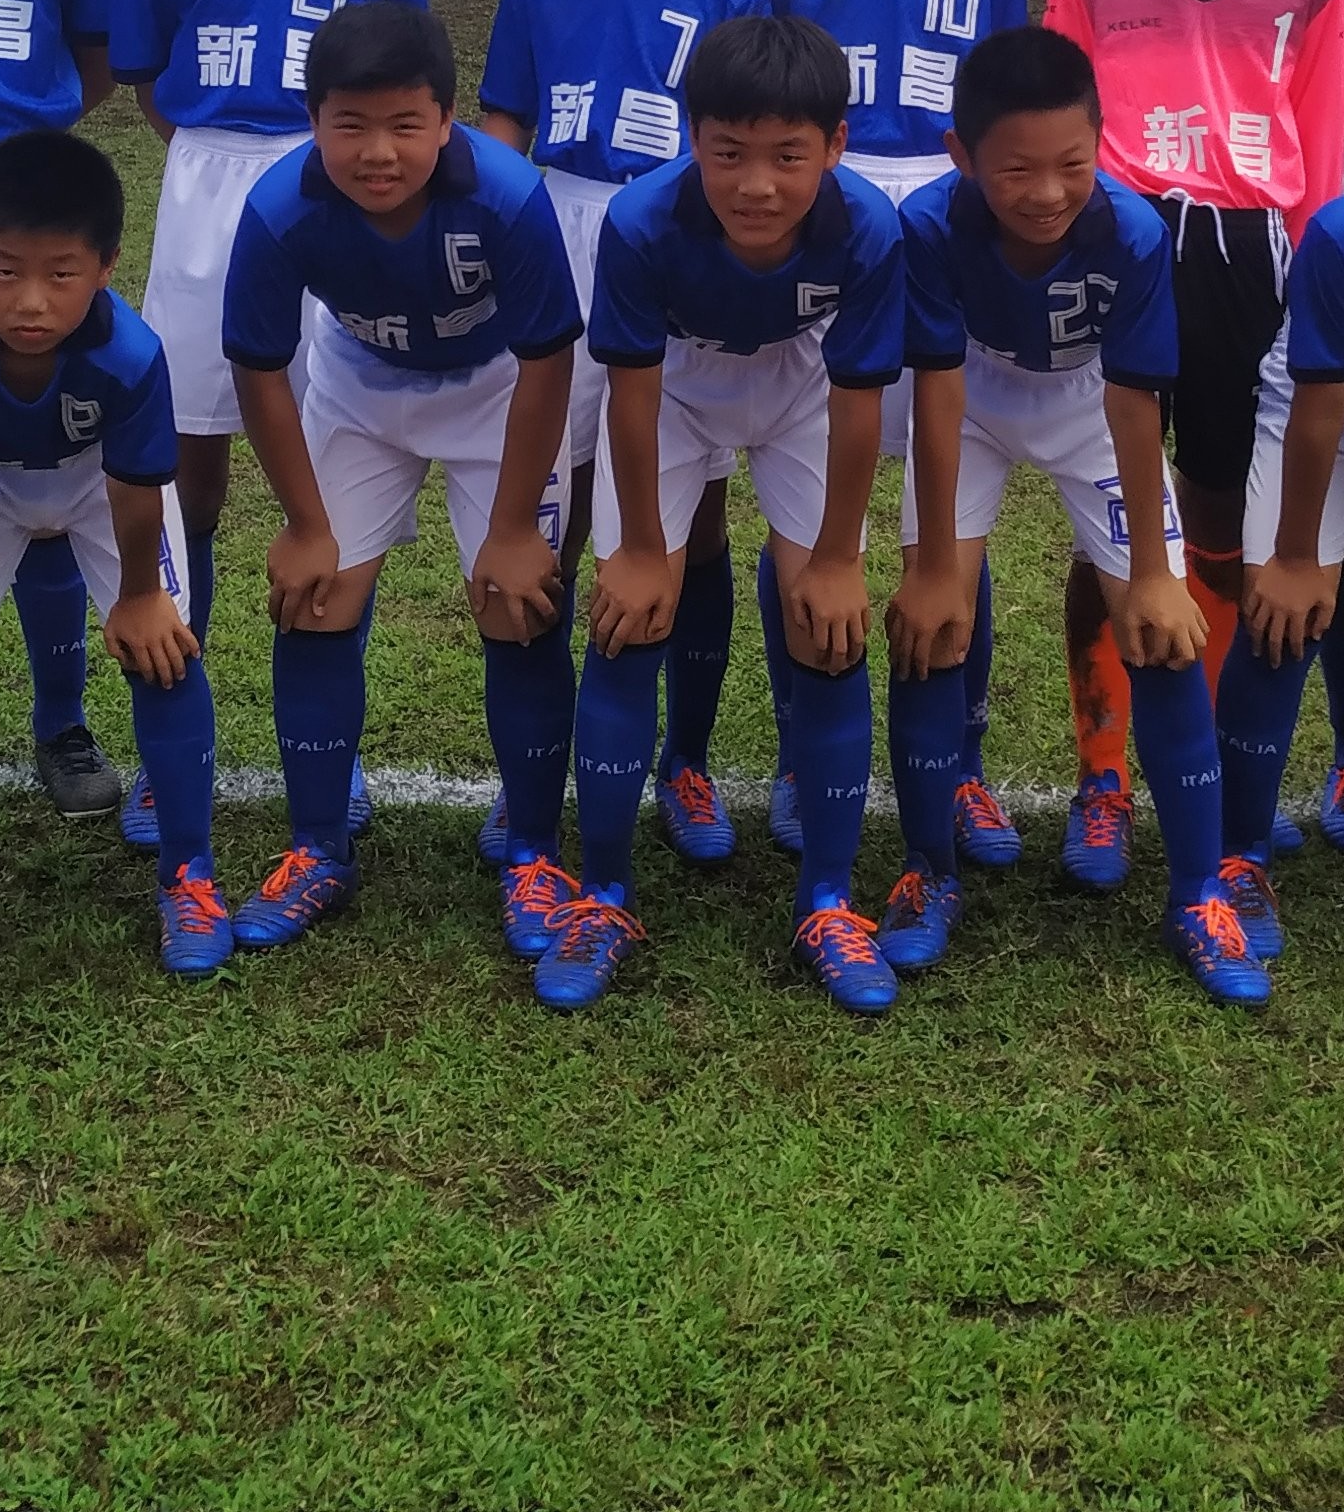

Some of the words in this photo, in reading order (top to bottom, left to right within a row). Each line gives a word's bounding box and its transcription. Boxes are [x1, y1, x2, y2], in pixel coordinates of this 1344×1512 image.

[660, 8, 700, 89] 7
[1270, 11, 1295, 83] 1
[547, 80, 681, 160] 新昌
[1143, 104, 1271, 182] 新昌
[445, 232, 492, 295] 6
[280, 736, 347, 752] ITALIA
[580, 755, 642, 775] ITALIA
